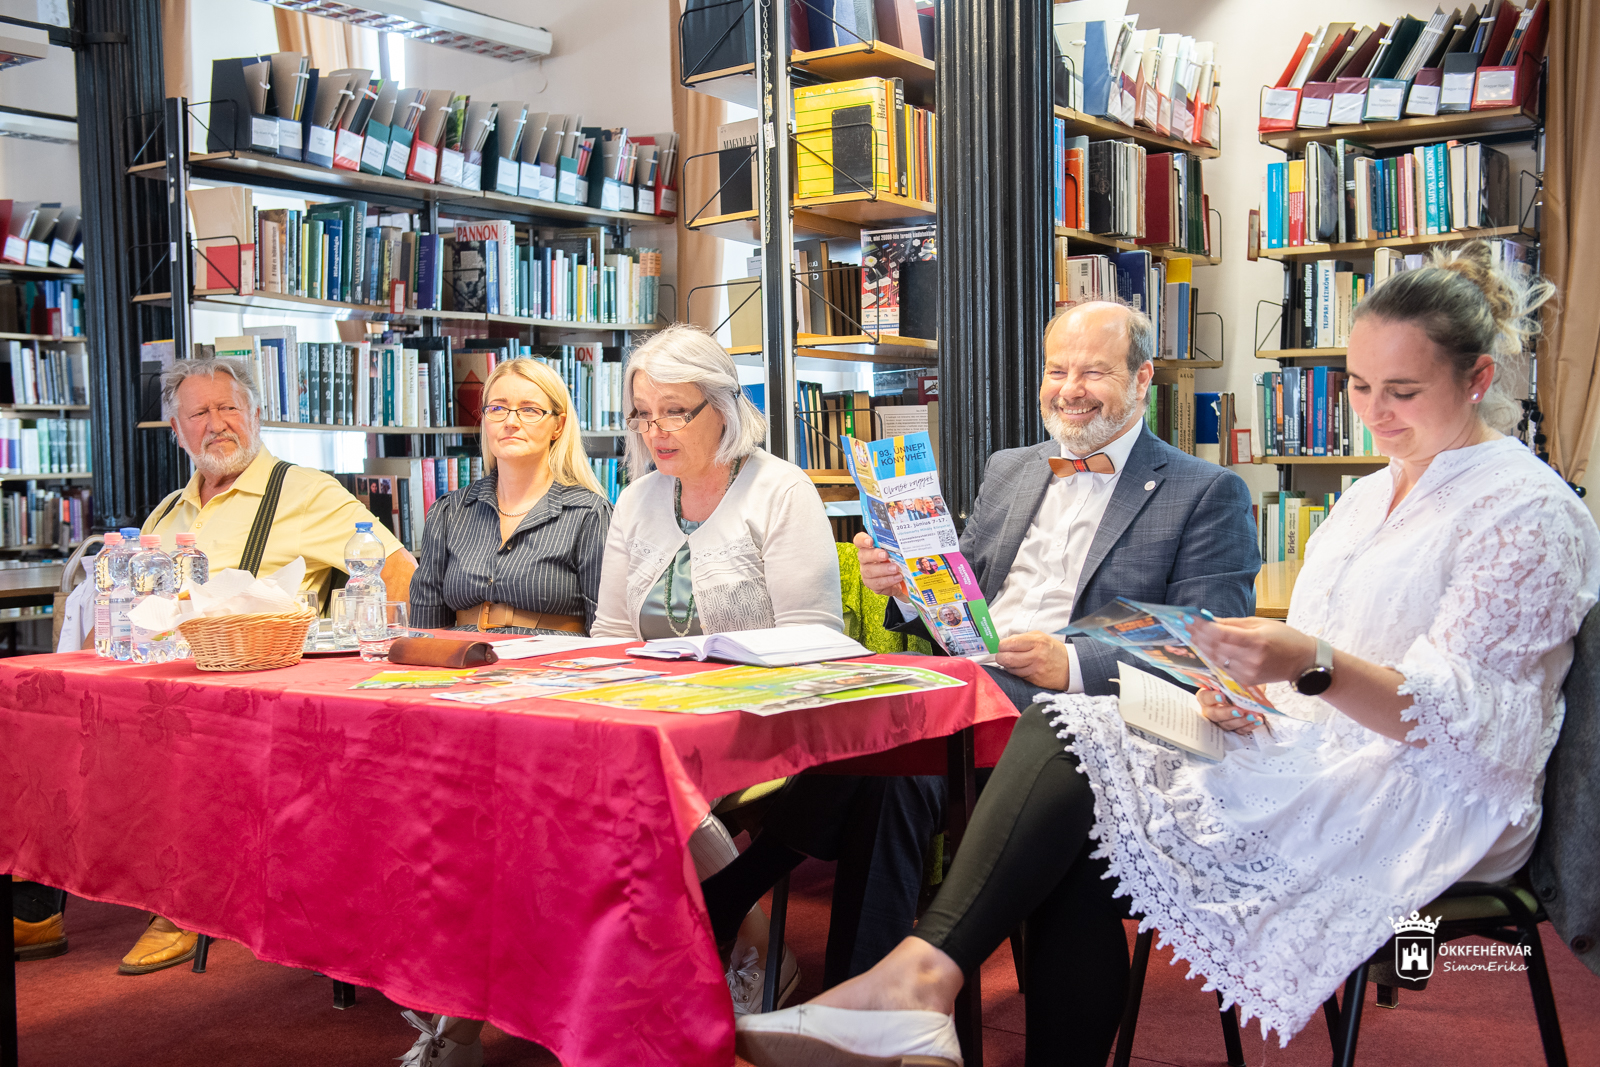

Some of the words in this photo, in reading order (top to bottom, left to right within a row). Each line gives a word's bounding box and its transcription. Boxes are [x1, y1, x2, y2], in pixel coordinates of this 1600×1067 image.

[457, 224, 499, 242] PANNON
[1304, 264, 1312, 297] KÉZIKÖNYV
[1304, 298, 1312, 327] HÚSIPARI
[879, 449, 892, 457] 93.
[894, 443, 926, 454] ÜNNEPI
[880, 450, 927, 466] KÖNYVHÉT
[883, 483, 907, 495] Olvasó
[909, 473, 934, 490] vagyok
